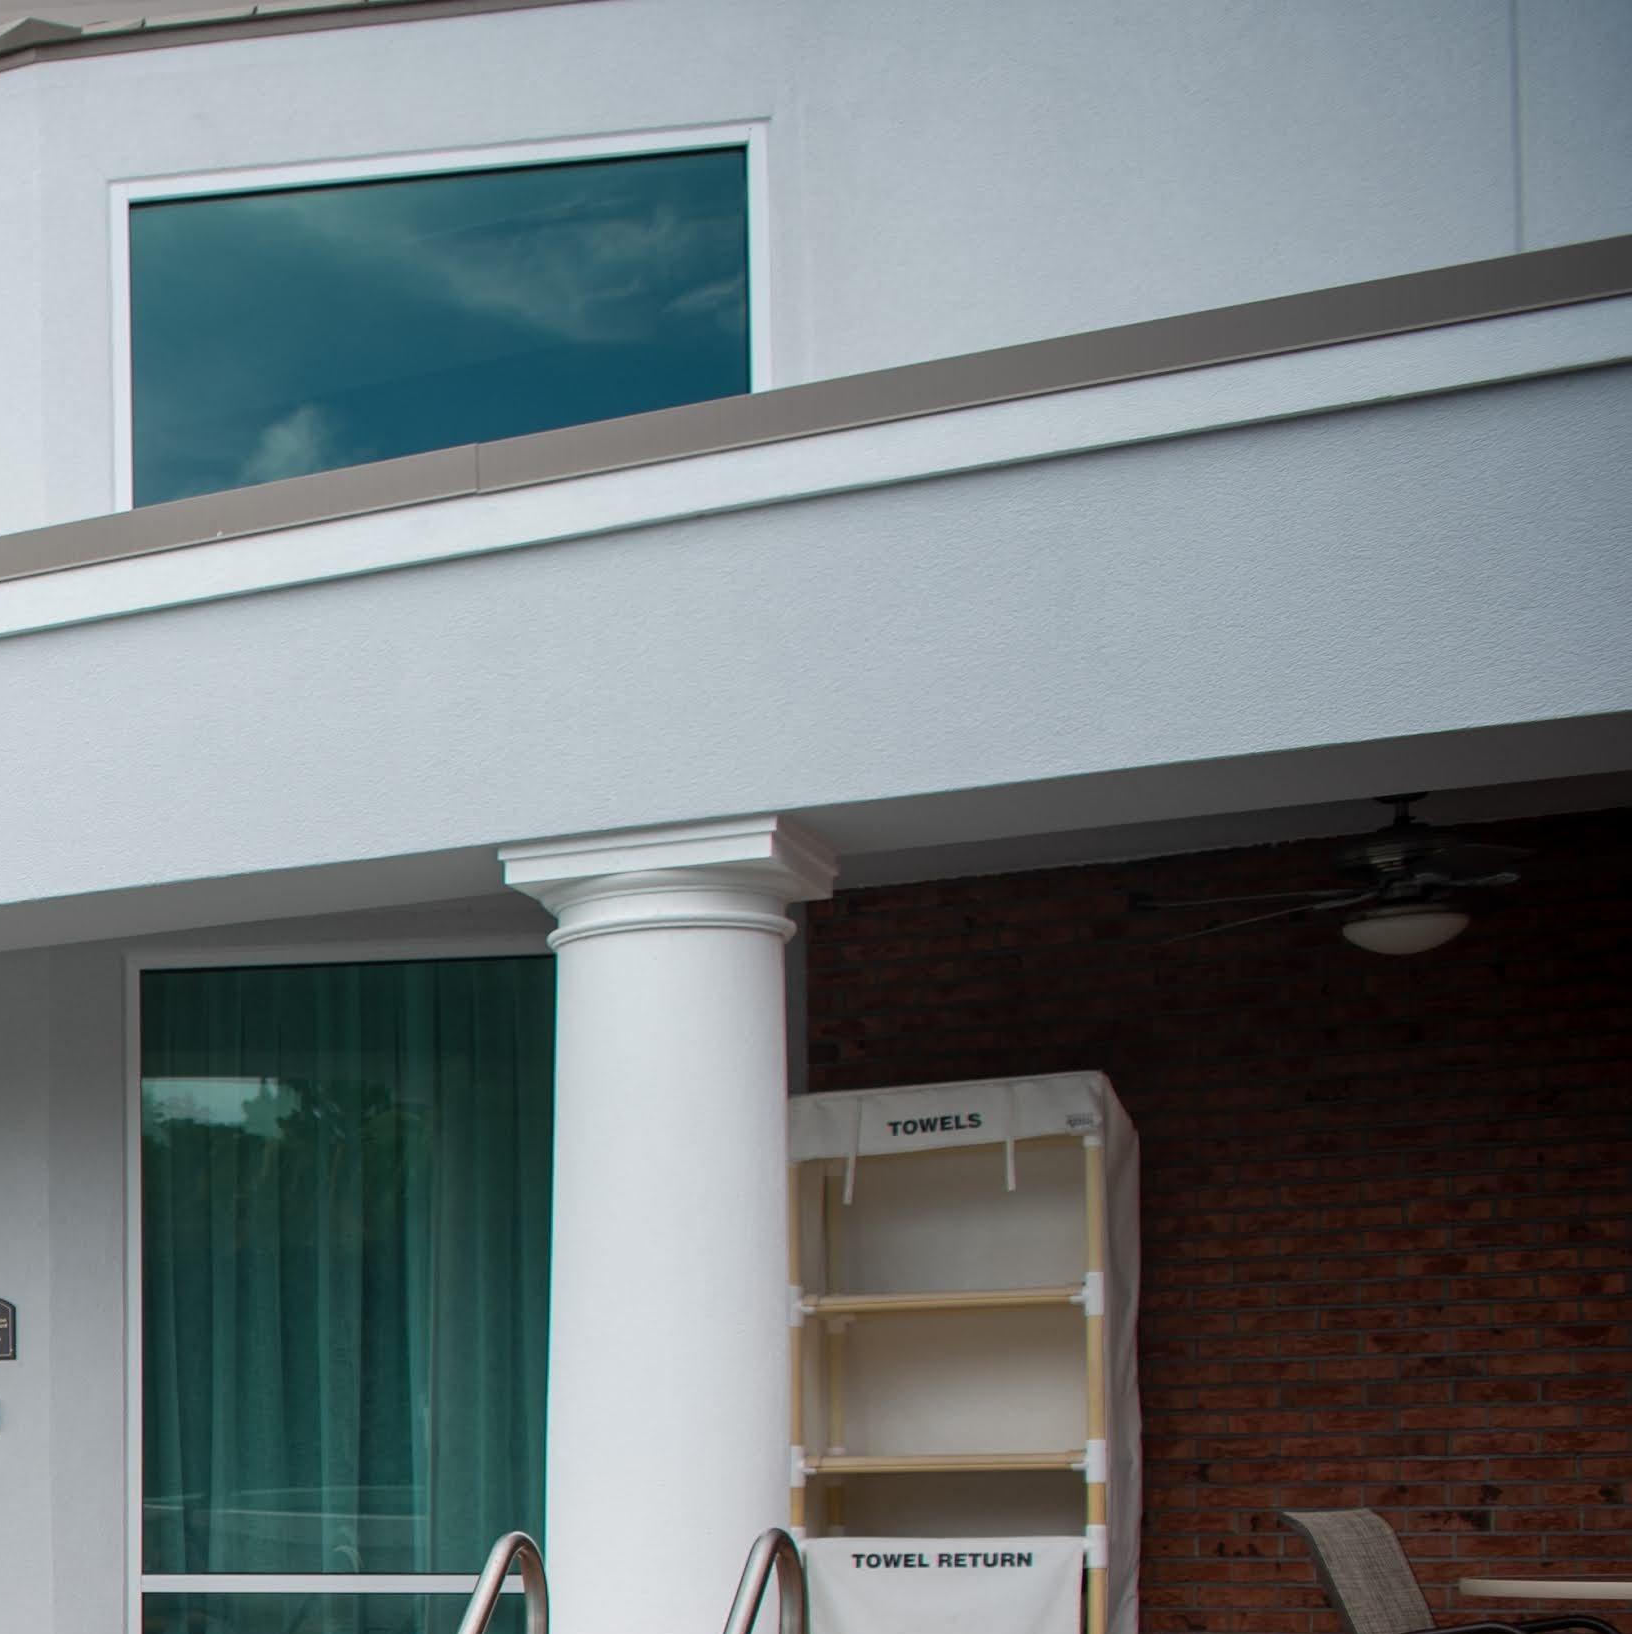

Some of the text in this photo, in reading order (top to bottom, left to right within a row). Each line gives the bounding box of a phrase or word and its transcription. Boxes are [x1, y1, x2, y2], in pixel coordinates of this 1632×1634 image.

[888, 1111, 983, 1137] TOWELS
[852, 1551, 1033, 1569] TOWEL RETURN
